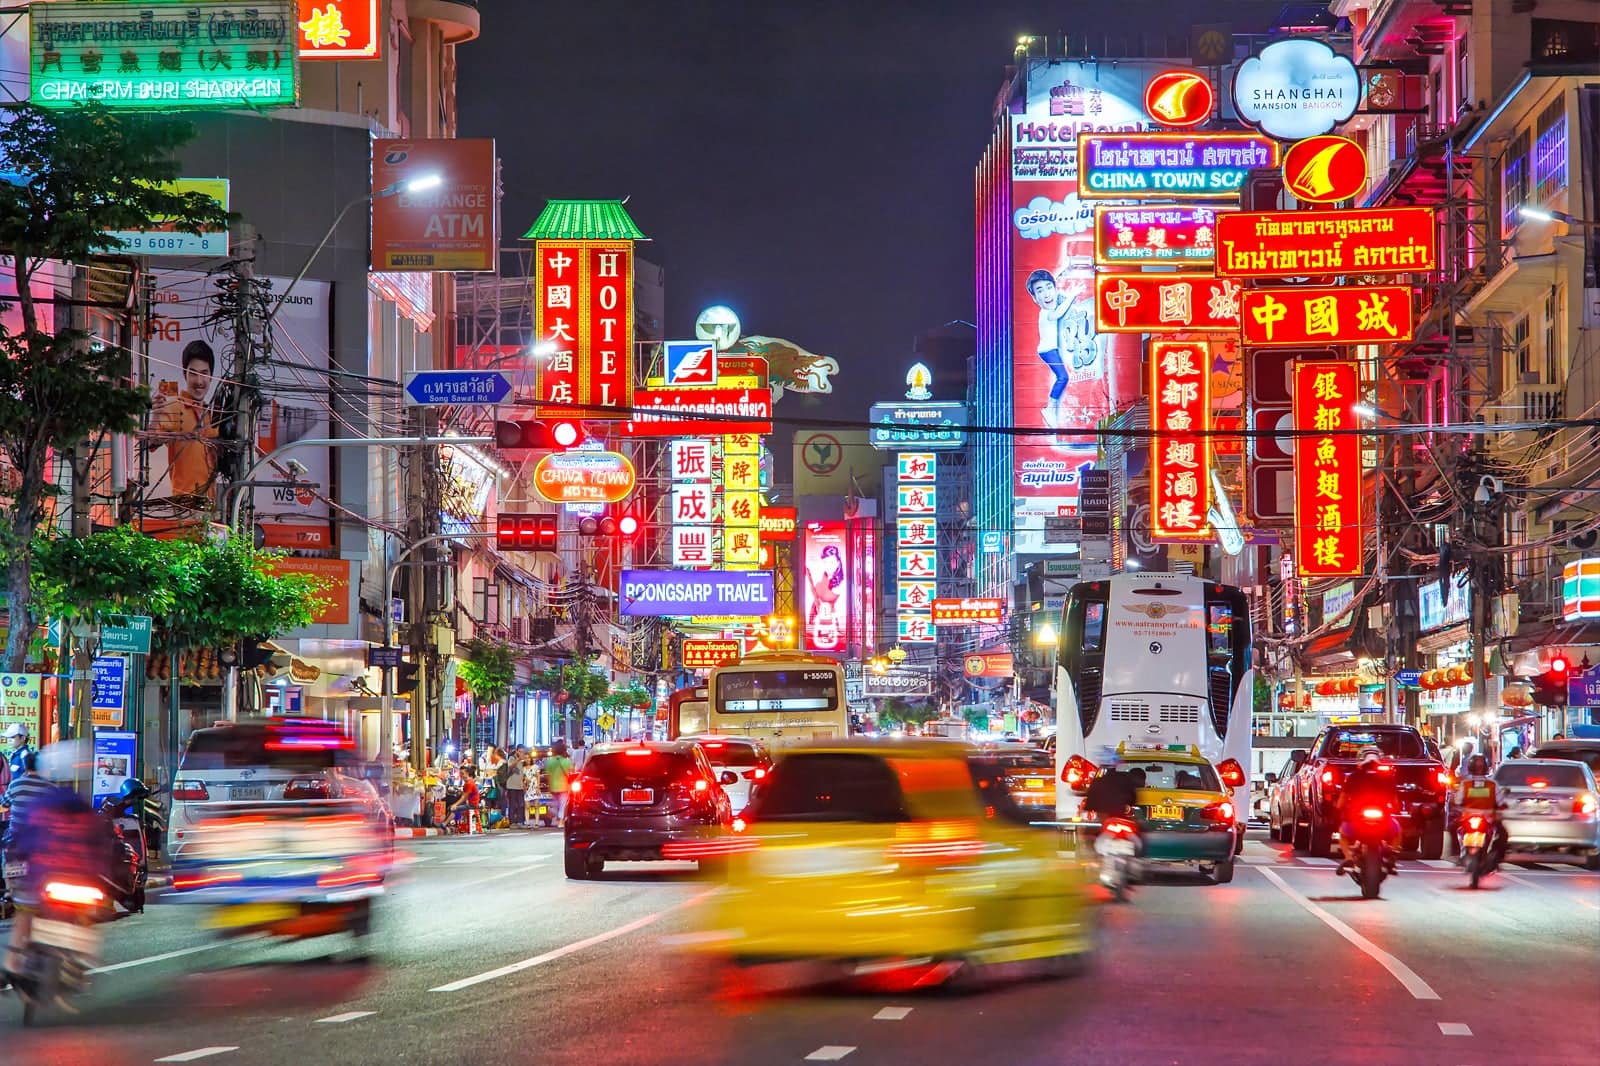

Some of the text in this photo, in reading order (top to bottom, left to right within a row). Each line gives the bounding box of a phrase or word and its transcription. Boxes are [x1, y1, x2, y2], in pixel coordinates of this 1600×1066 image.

[1253, 87, 1343, 100] SHANGHAI
[1253, 101, 1343, 110] MANSION BANGKOK
[1016, 121, 1077, 143] Hotel
[1091, 172, 1146, 188] CHINA
[1152, 172, 1205, 188] TOWN
[423, 213, 485, 238] ATM
[149, 238, 184, 250] 6087
[201, 240, 209, 250] 8
[1108, 248, 1152, 257] SHARK'S
[1156, 248, 1173, 257] FIN
[1223, 236, 1428, 270] ไชน่าทาวน์ สกาล่า
[1105, 279, 1241, 327] 中國城
[1251, 292, 1398, 341] 中國城
[546, 250, 575, 405] 中國大酒店
[598, 253, 619, 408] HOTEL
[429, 395, 449, 403] Song
[541, 469, 630, 485] CHINA TOWN
[1311, 371, 1345, 568] 銀都魚翅酒樓
[1023, 470, 1075, 486] สมุนไพร
[563, 485, 607, 497] HOTEL
[717, 583, 768, 602] TRAVEL
[5, 689, 26, 697] true
